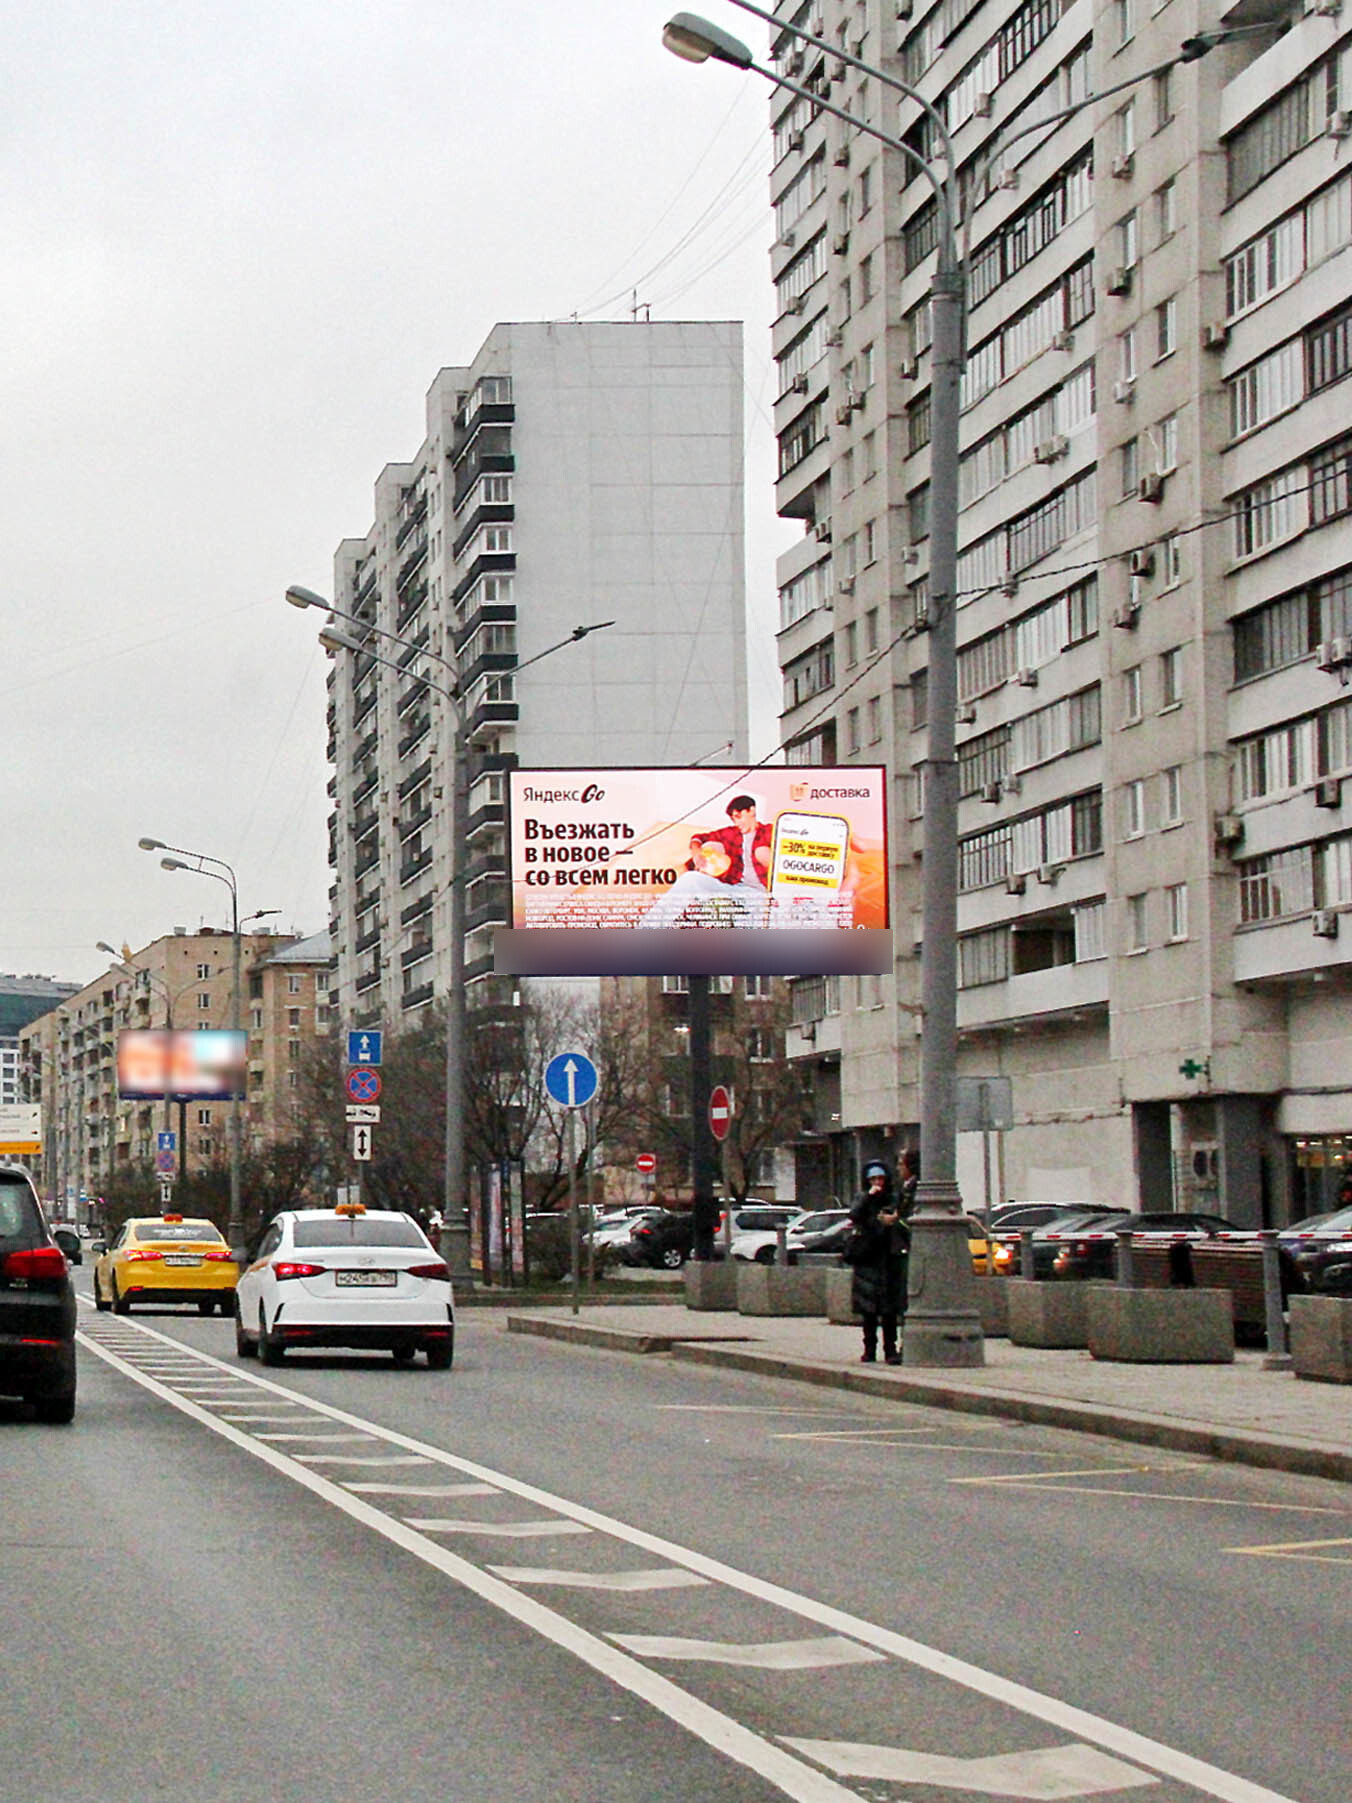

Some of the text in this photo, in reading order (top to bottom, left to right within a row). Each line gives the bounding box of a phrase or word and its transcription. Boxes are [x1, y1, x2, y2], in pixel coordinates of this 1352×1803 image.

[523, 784, 605, 803] Яндекс Go
[810, 788, 870, 799] доставка
[524, 819, 634, 840] Въезжать
[525, 847, 538, 862] в
[543, 847, 610, 862] новое
[783, 859, 835, 874] OGOCARGO
[525, 869, 678, 886] со всем легко
